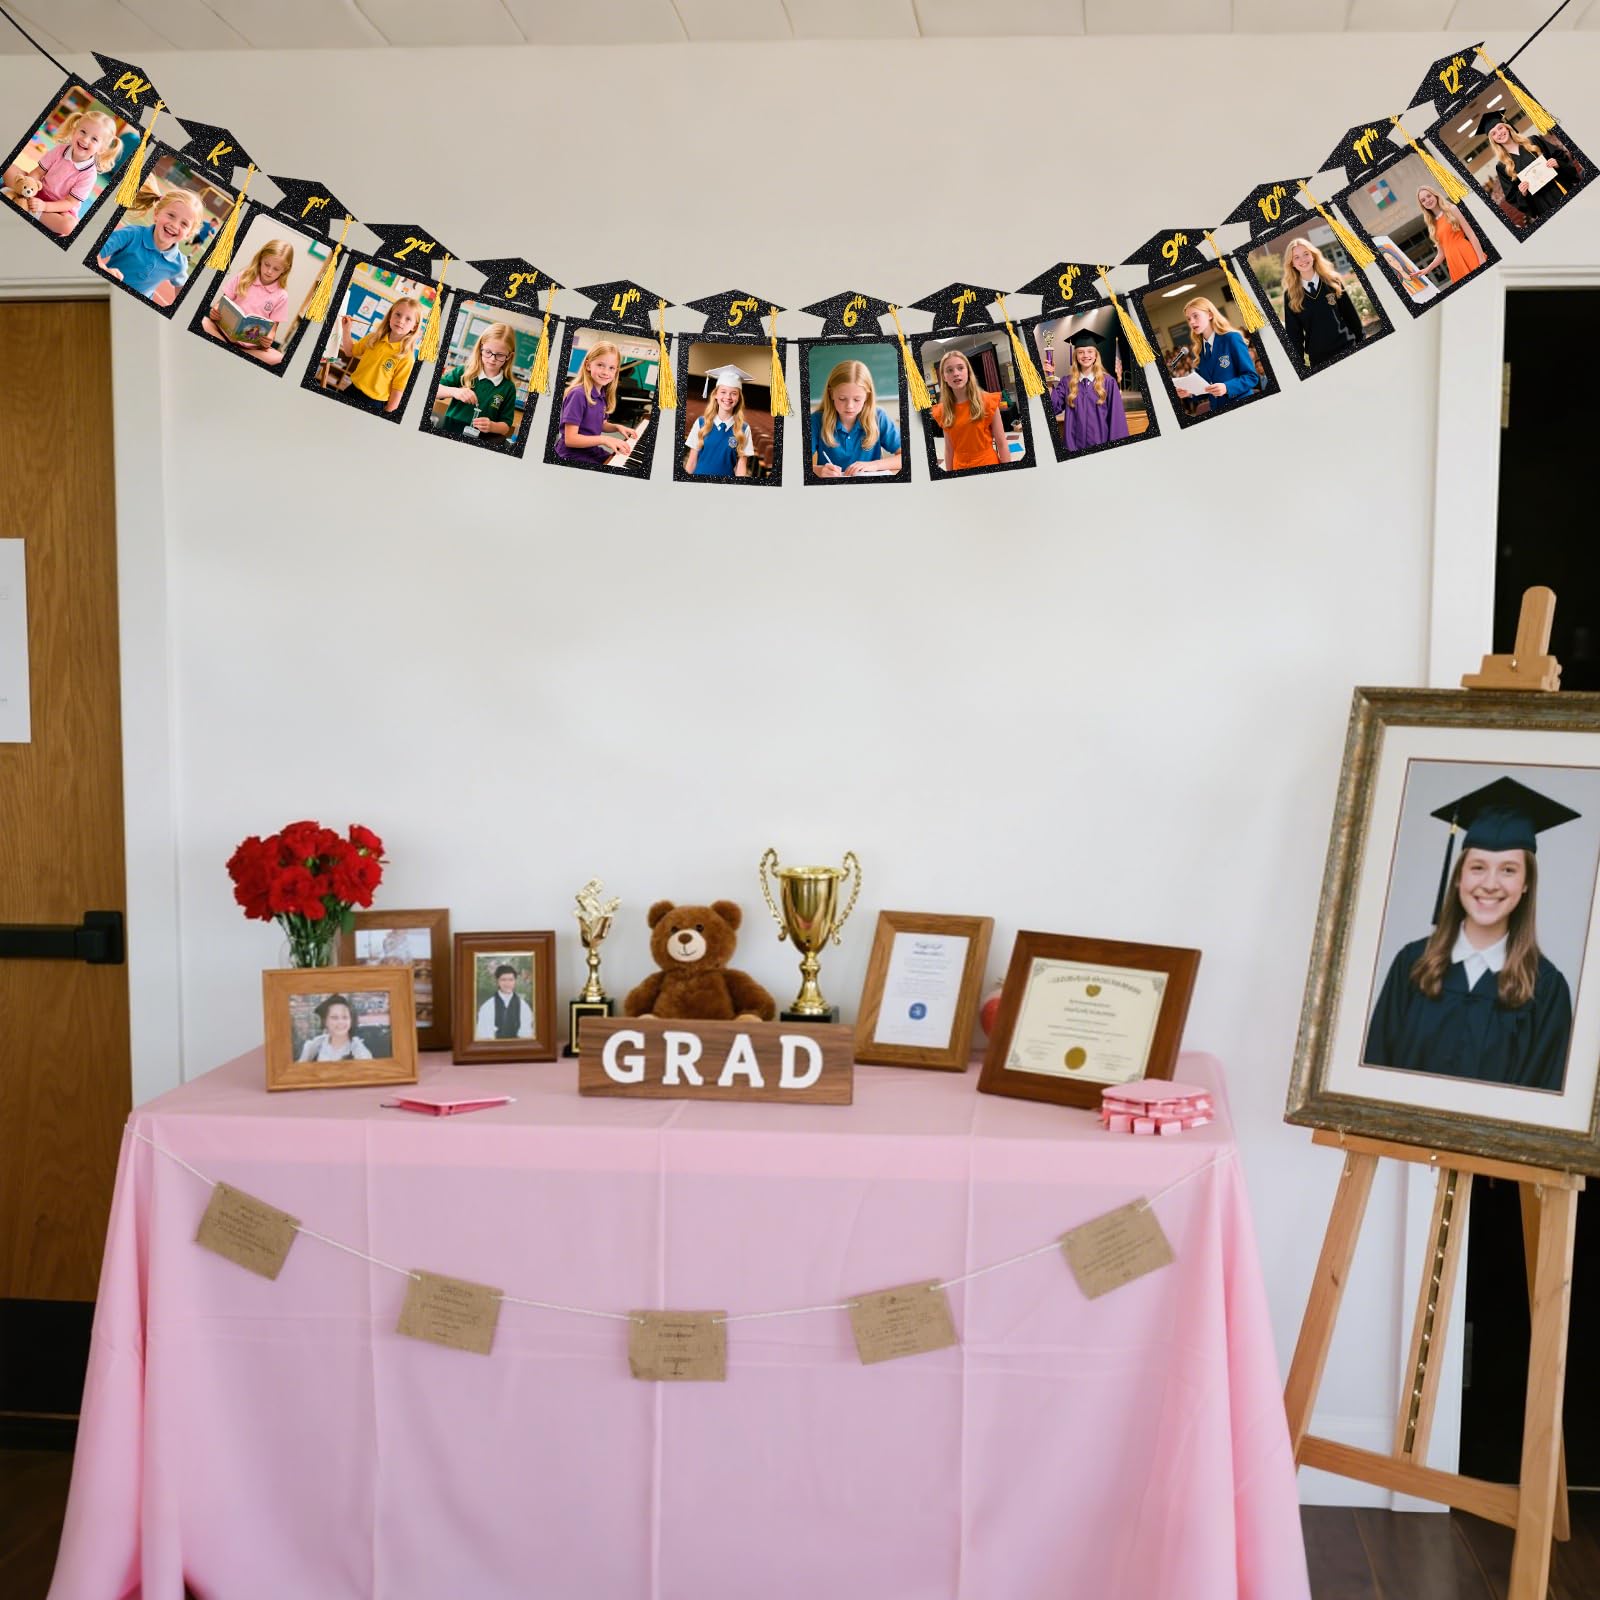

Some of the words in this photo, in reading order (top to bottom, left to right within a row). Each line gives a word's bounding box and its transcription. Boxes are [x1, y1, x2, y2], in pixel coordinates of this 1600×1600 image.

[113, 71, 152, 104] PK
[1438, 55, 1467, 94] 12th
[206, 140, 233, 167] K
[1352, 127, 1379, 165] 11th
[301, 196, 331, 218] 1st
[1257, 185, 1287, 223] 10th
[393, 236, 435, 260] 2nd
[1161, 233, 1188, 266] 9th
[504, 271, 538, 299] 3rd
[1058, 265, 1081, 301] 8th
[611, 288, 641, 319] 4th
[727, 298, 759, 327] 5th
[842, 296, 867, 328] 6th
[951, 289, 977, 324] 7th
[602, 1030, 823, 1089] GRAD
